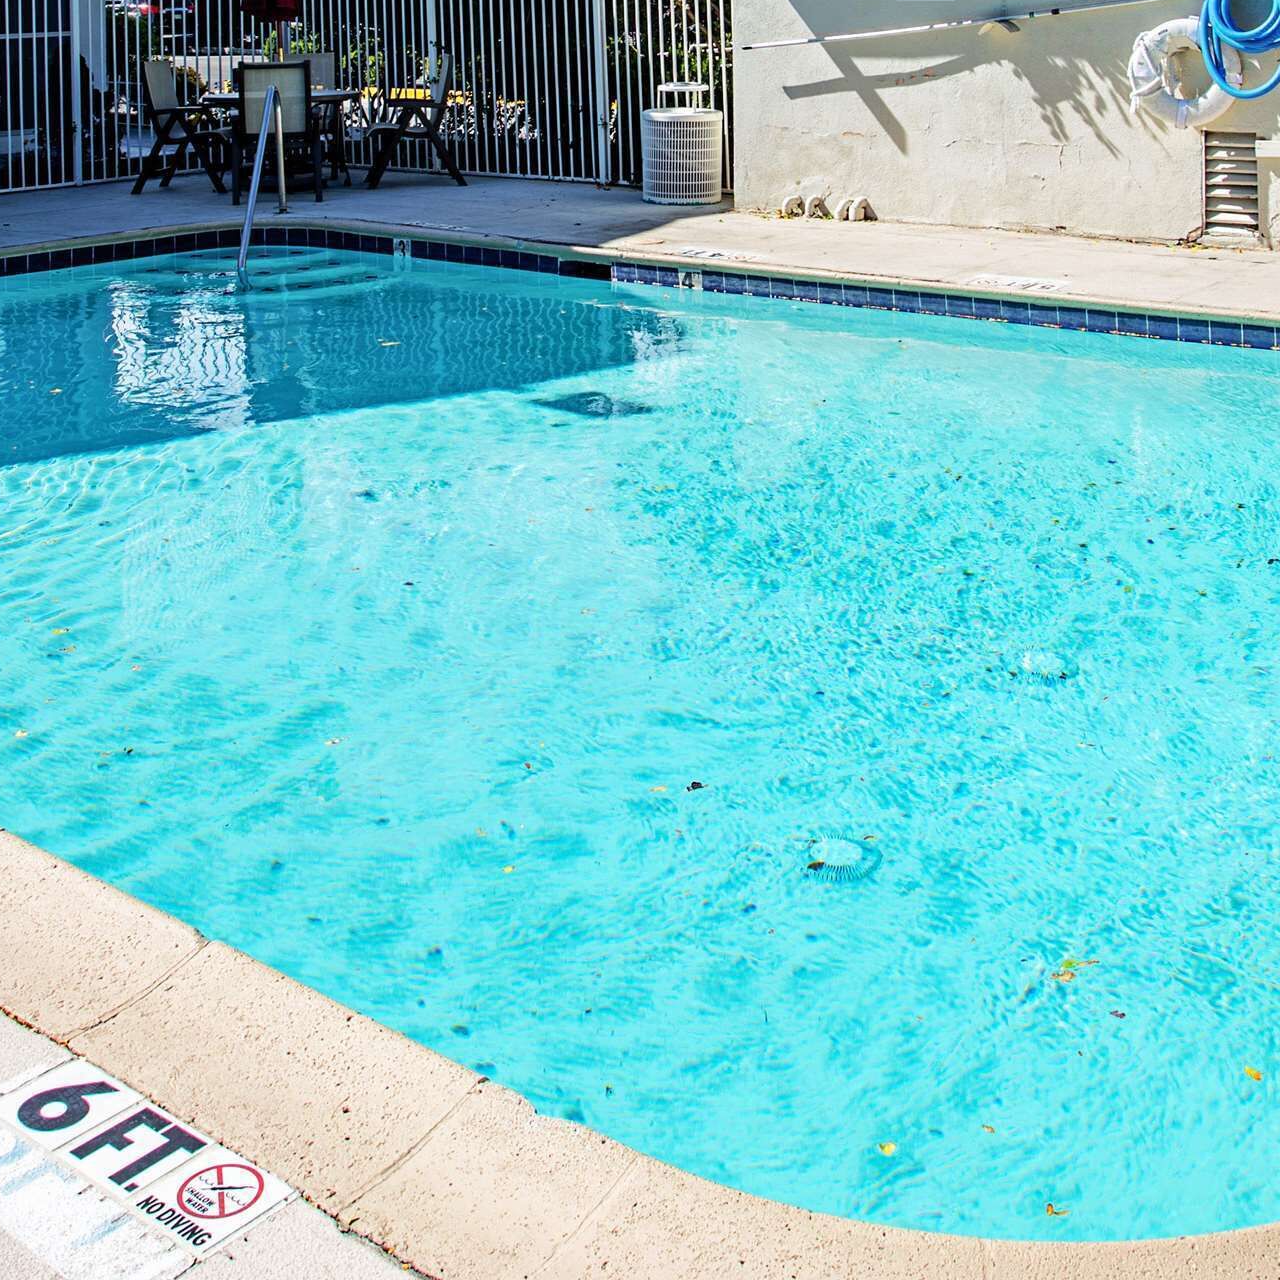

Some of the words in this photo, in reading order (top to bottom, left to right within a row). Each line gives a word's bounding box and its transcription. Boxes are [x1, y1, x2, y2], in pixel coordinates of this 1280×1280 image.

[682, 272, 694, 289] 4
[16, 1080, 121, 1133] 6
[184, 1186, 217, 1207] SHALLOW
[184, 1197, 210, 1214] WATER
[136, 1194, 166, 1215] NO
[155, 1208, 212, 1247] DIVING
